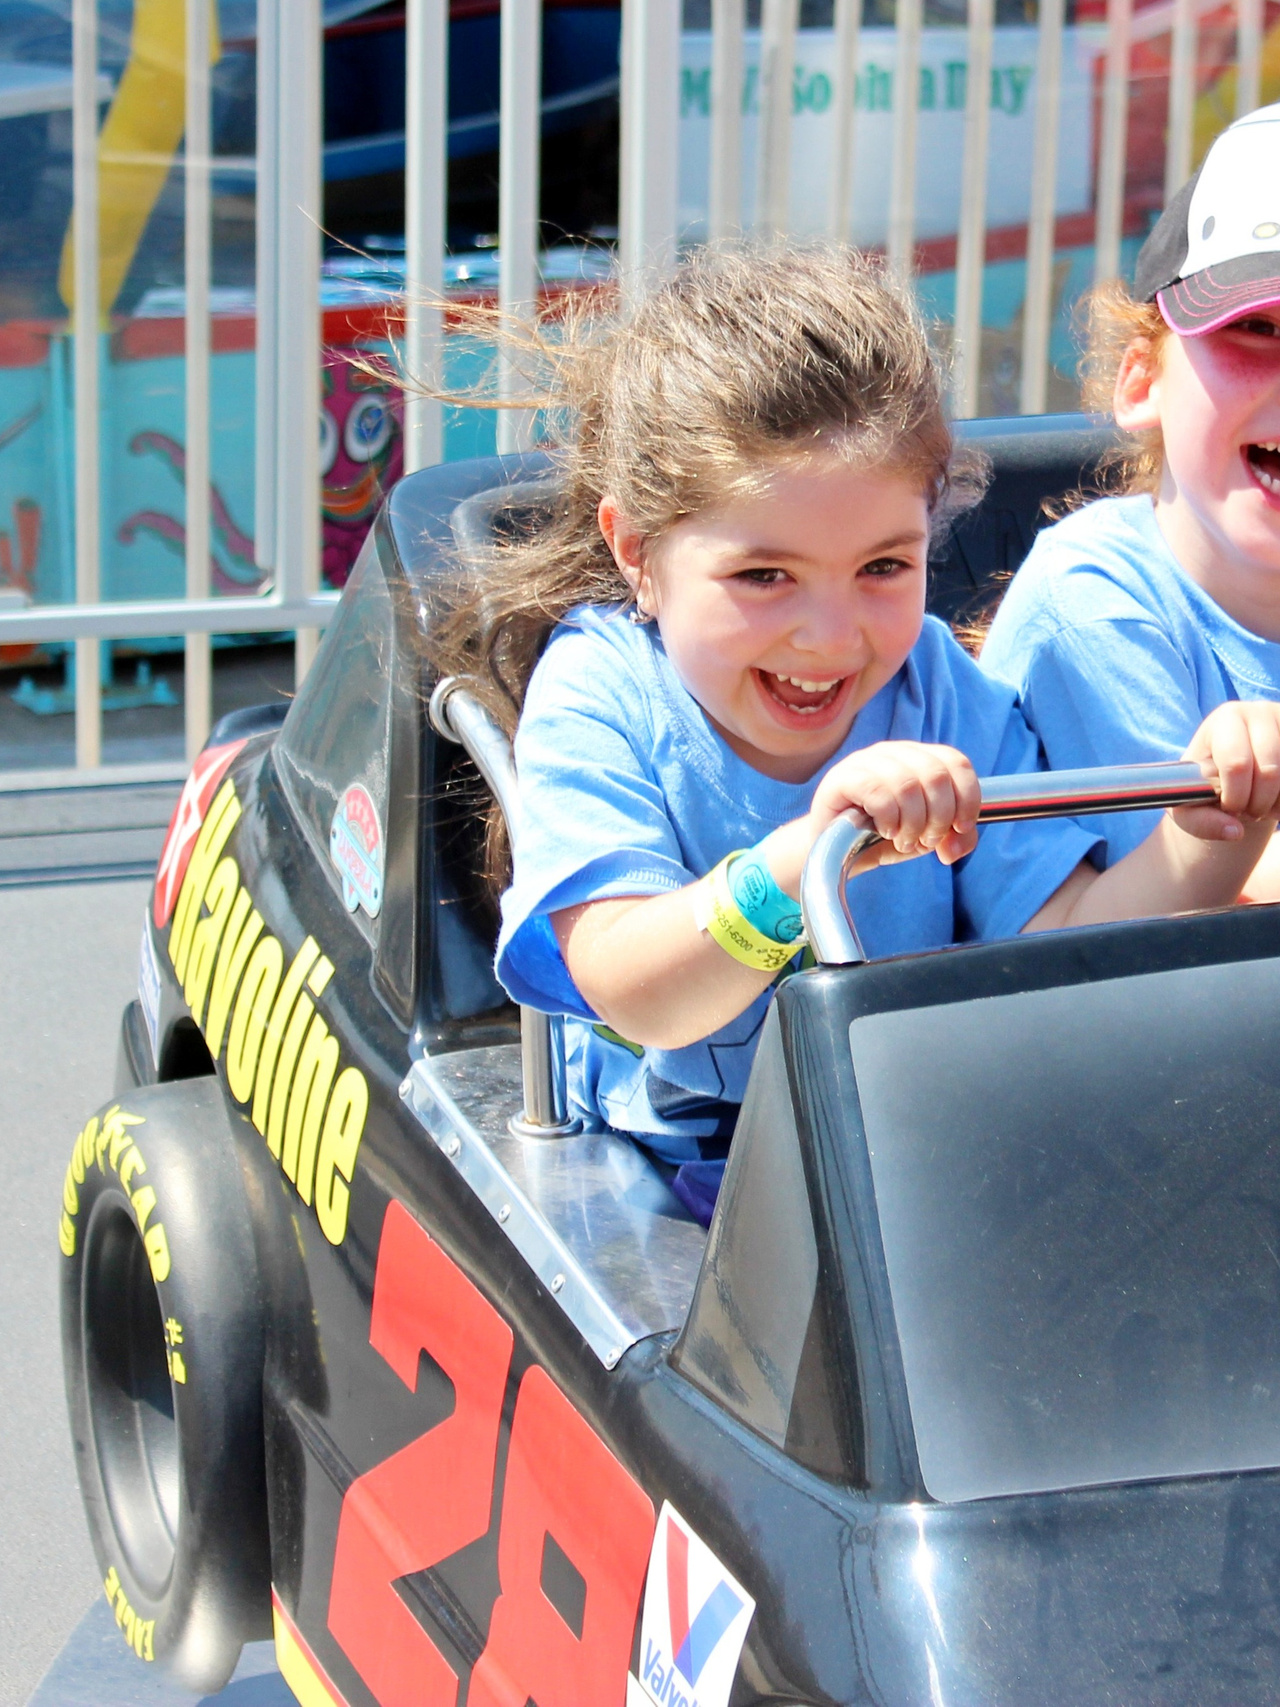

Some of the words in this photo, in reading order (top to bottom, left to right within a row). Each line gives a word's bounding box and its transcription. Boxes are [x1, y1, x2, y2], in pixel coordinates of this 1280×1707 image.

[168, 778, 370, 1246] Havoline
[58, 1104, 171, 1283] GOODYEAR
[103, 1565, 155, 1662] EAGLE
[327, 1199, 655, 1707] 28
